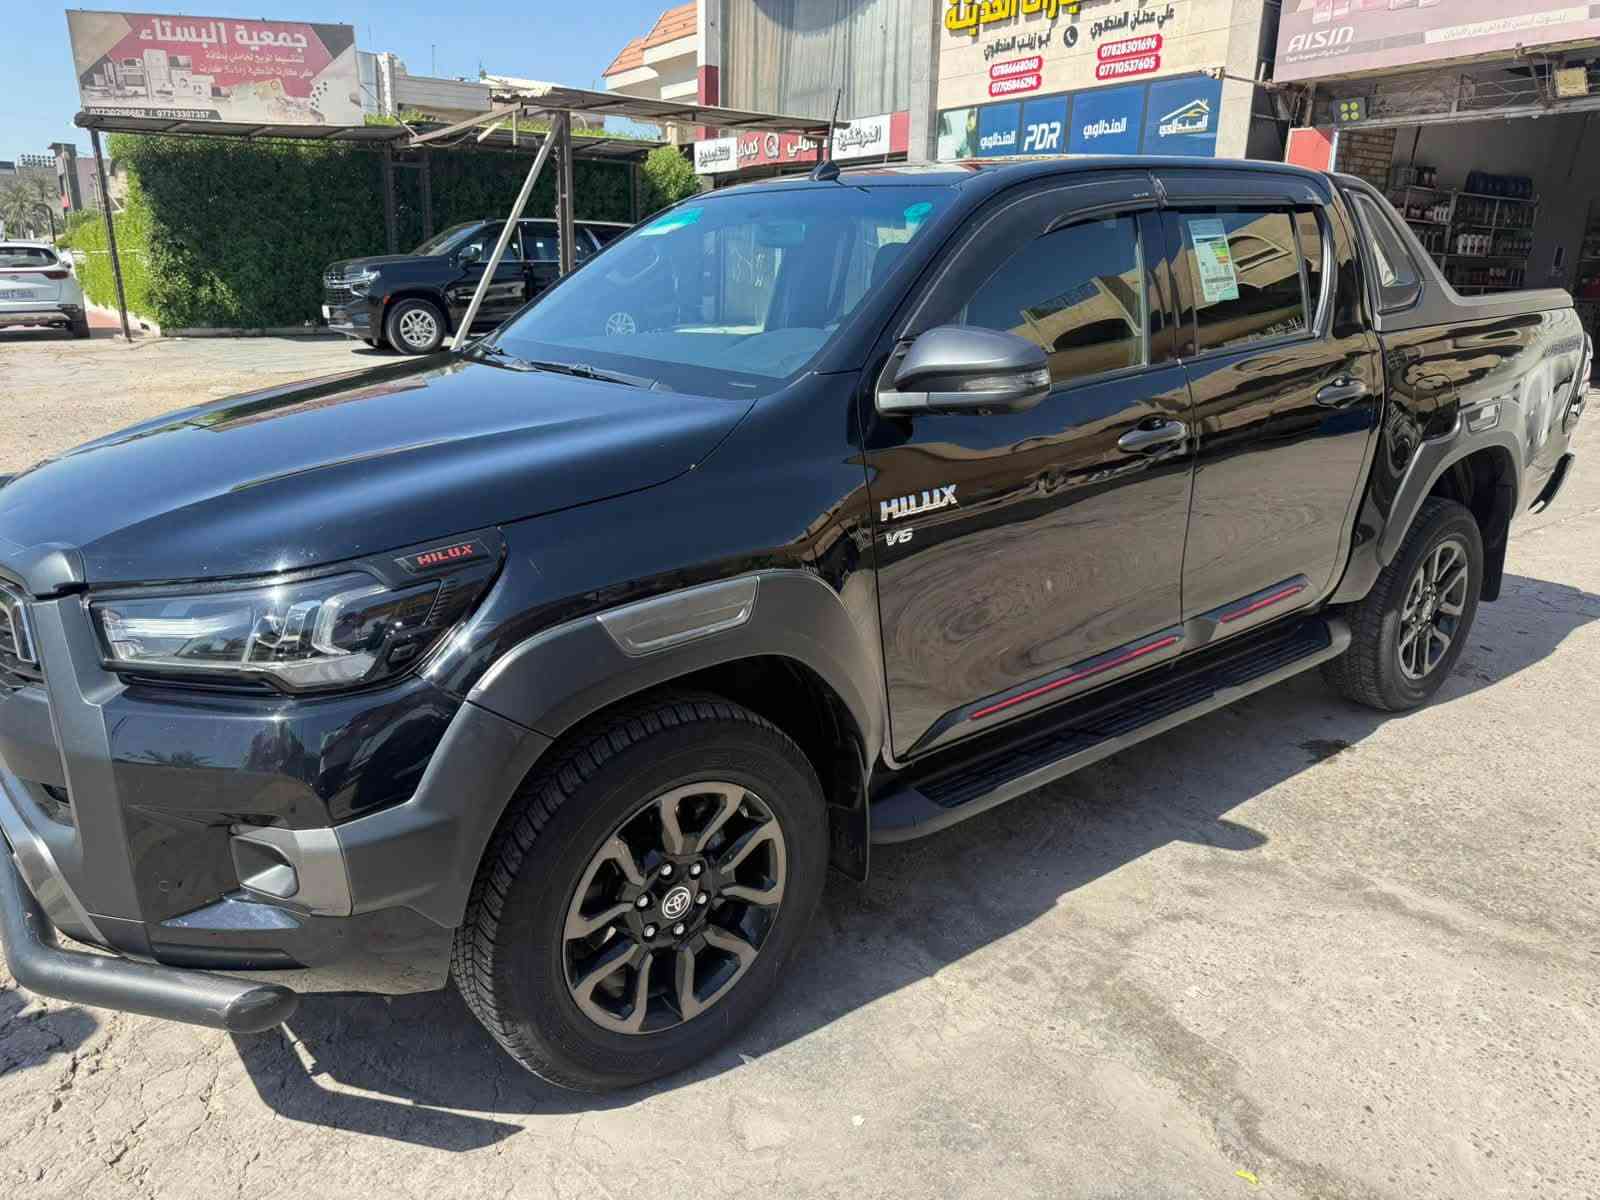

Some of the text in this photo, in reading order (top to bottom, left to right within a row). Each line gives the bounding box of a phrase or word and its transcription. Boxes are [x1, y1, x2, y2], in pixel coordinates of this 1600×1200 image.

[1157, 4, 1175, 28] علي
[235, 24, 308, 52] جمعية
[1288, 26, 1353, 53] AISIN
[980, 130, 1016, 149] المندلاوي
[1023, 121, 1061, 151] PDR
[1083, 117, 1127, 139] المندلاوي
[880, 484, 958, 521] HILUX
[886, 528, 913, 546] V6
[416, 544, 473, 567] HILUX
